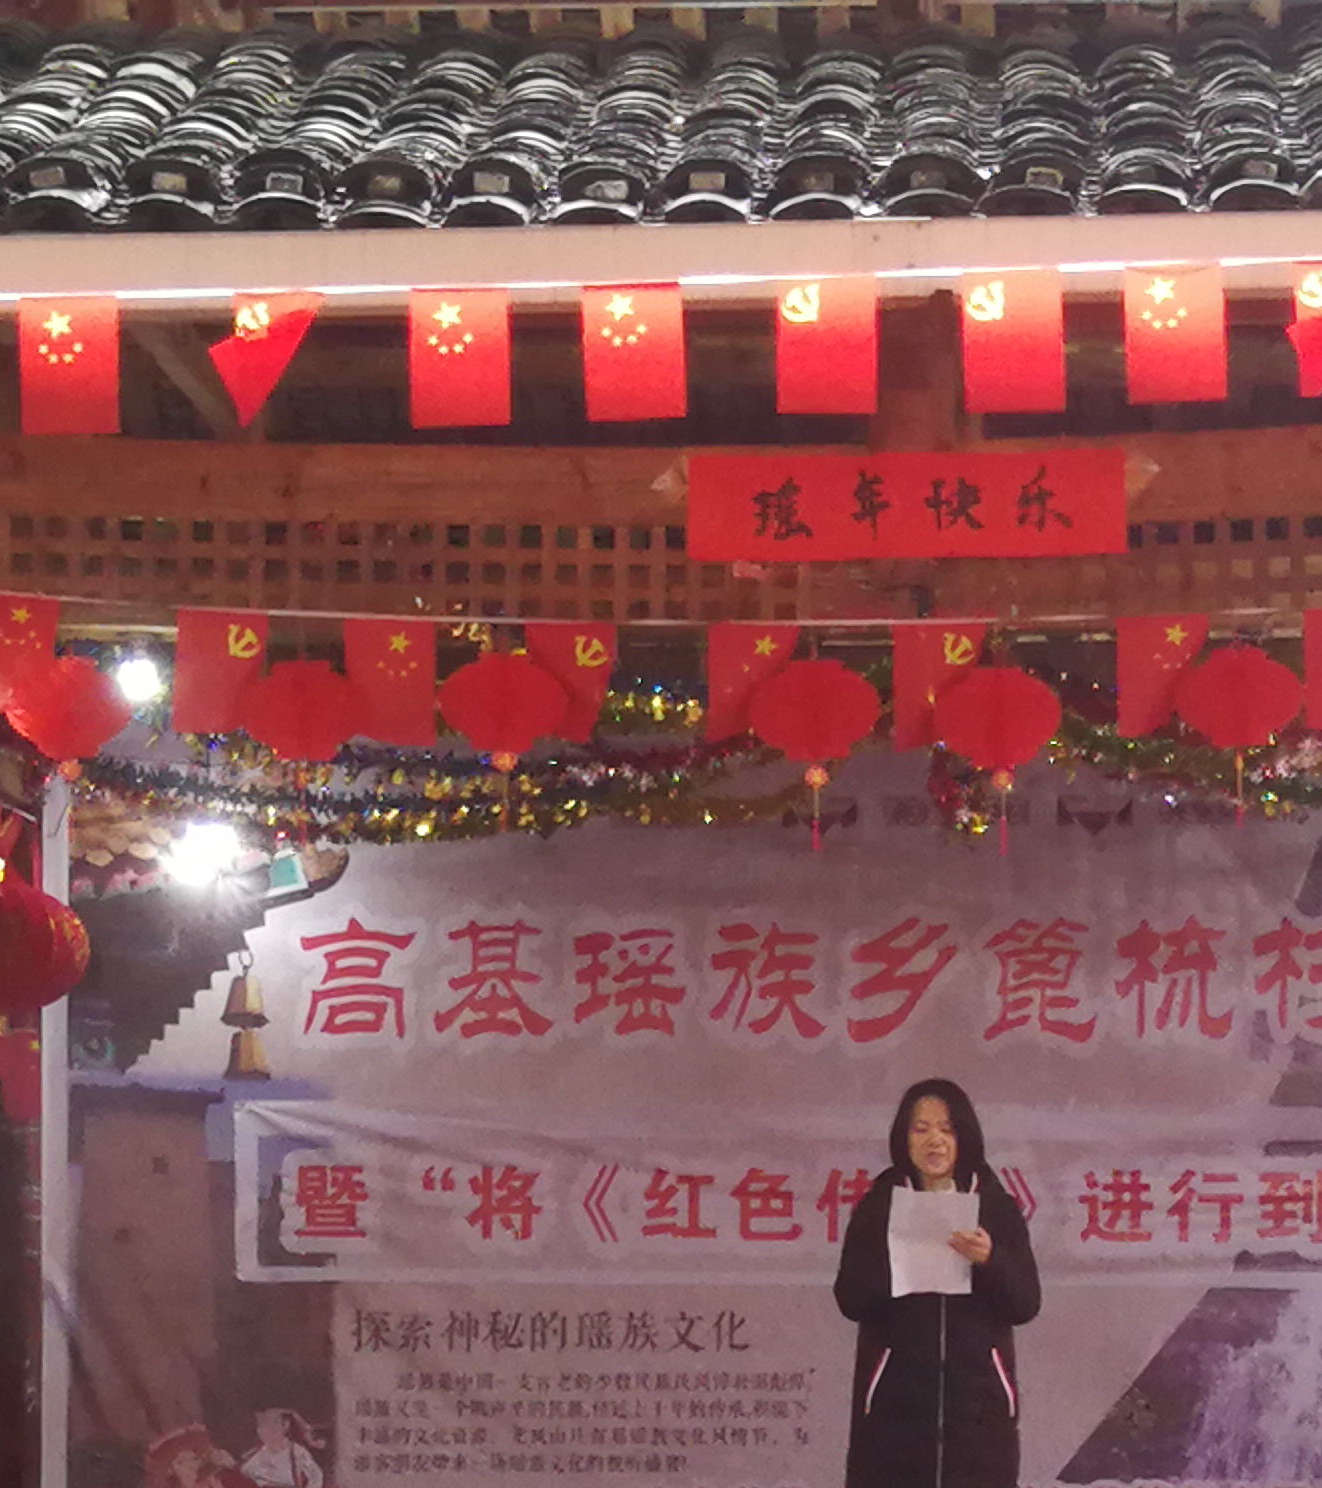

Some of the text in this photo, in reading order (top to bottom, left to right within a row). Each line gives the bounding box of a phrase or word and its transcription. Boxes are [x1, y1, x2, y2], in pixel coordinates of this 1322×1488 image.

[352, 1309, 750, 1354] 探索神秘的瑶族文化
